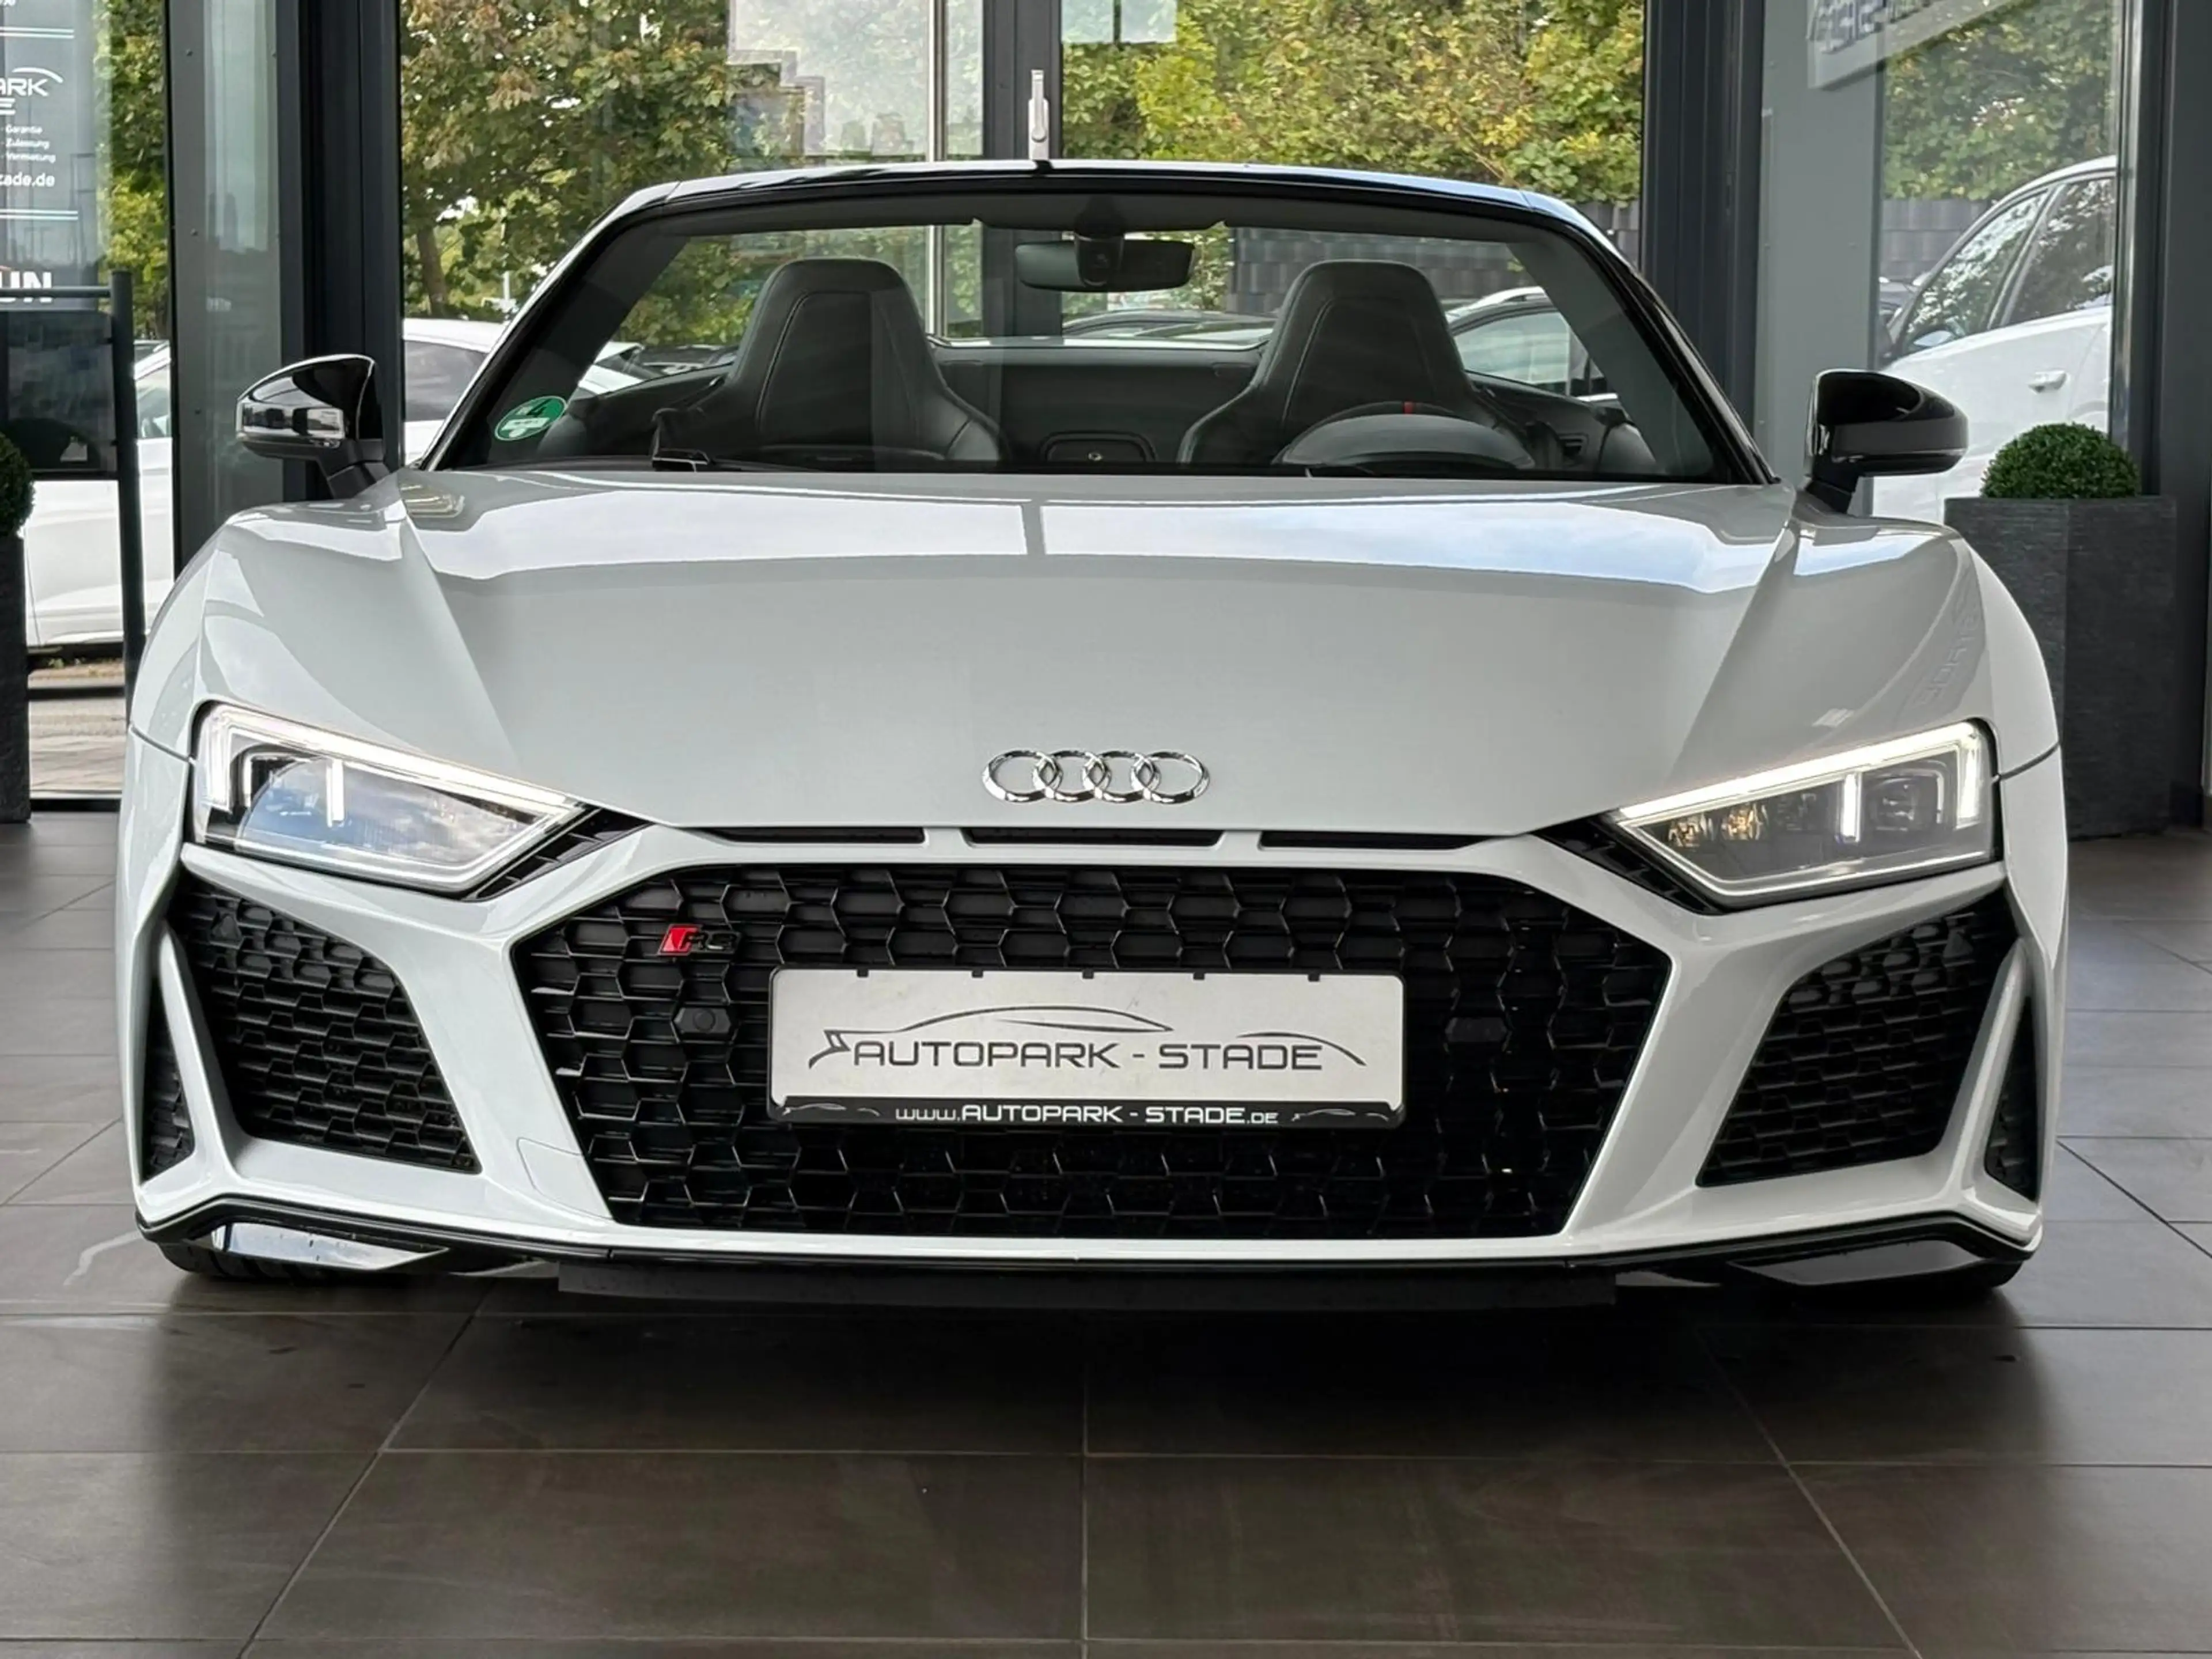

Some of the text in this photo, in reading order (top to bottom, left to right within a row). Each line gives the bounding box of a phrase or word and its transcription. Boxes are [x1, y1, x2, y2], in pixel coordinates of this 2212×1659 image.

[854, 1040, 1121, 1068] AUTOPARK
[1158, 1043, 1323, 1070] STADE
[895, 1104, 1123, 1123] www.AUTOPARK
